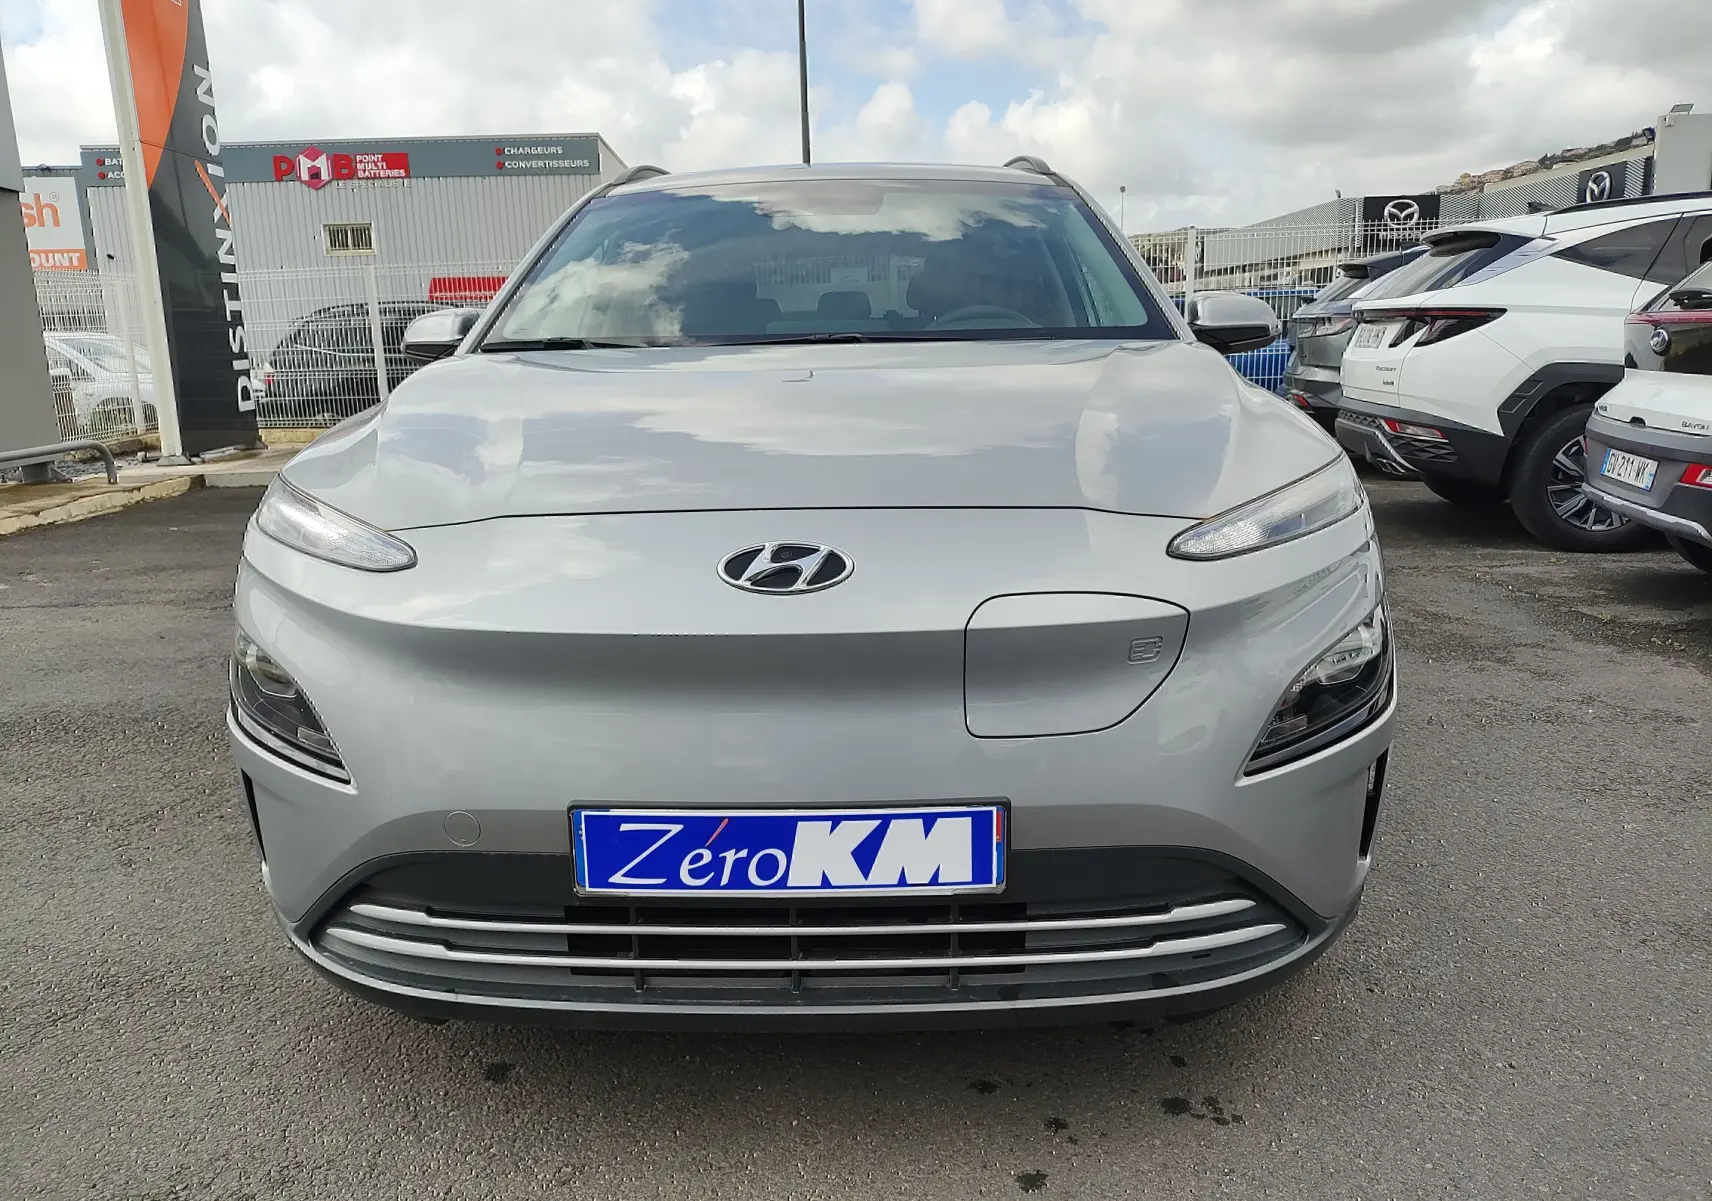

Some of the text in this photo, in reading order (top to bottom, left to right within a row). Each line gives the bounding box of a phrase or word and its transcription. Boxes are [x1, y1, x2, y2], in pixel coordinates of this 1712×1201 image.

[504, 147, 564, 155] CHARGEURS
[356, 154, 383, 163] POINT
[357, 162, 386, 170] MULTI
[504, 160, 590, 168] CONVERTISSEURS
[358, 169, 406, 178] BATTERIES
